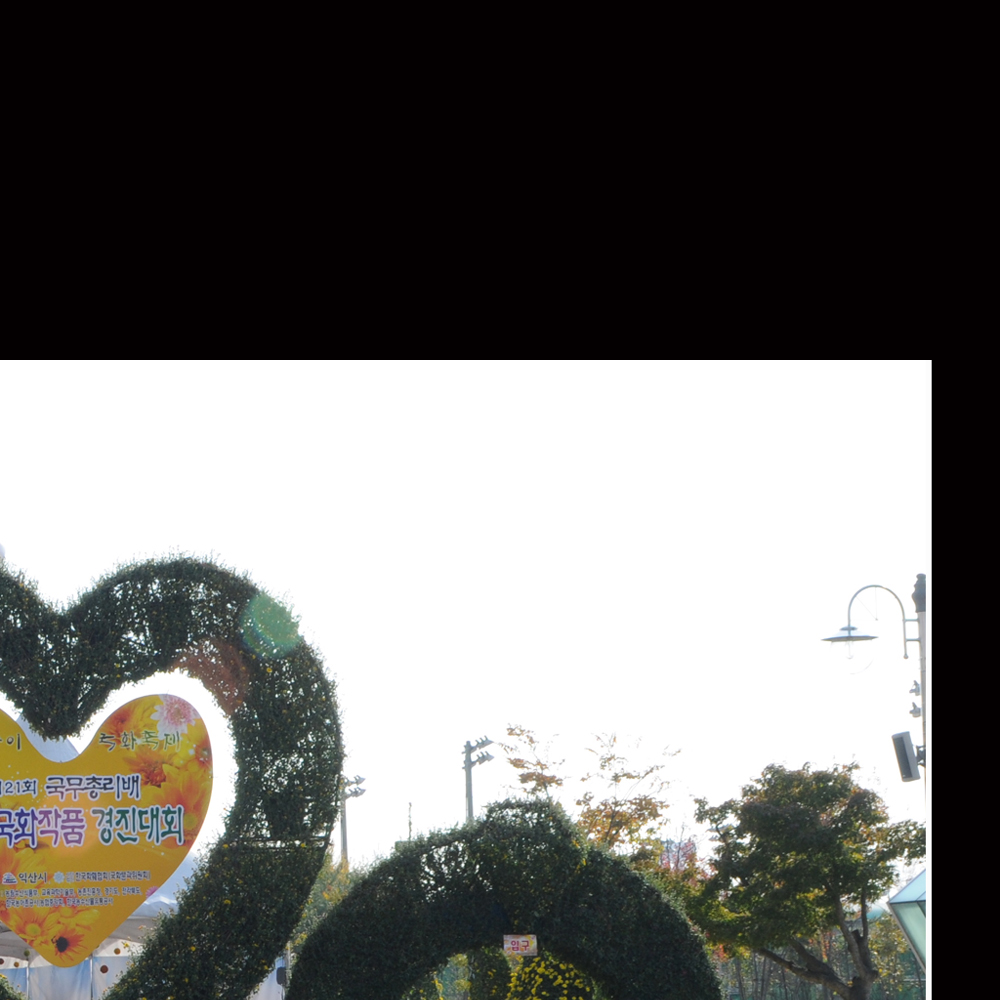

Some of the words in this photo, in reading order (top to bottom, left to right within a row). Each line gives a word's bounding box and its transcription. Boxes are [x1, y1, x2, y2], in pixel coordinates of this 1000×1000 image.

[99, 730, 181, 752] 국화축제
[45, 774, 141, 800] 국무총리배
[92, 806, 184, 845] 경진대회
[511, 940, 529, 951] 입구
